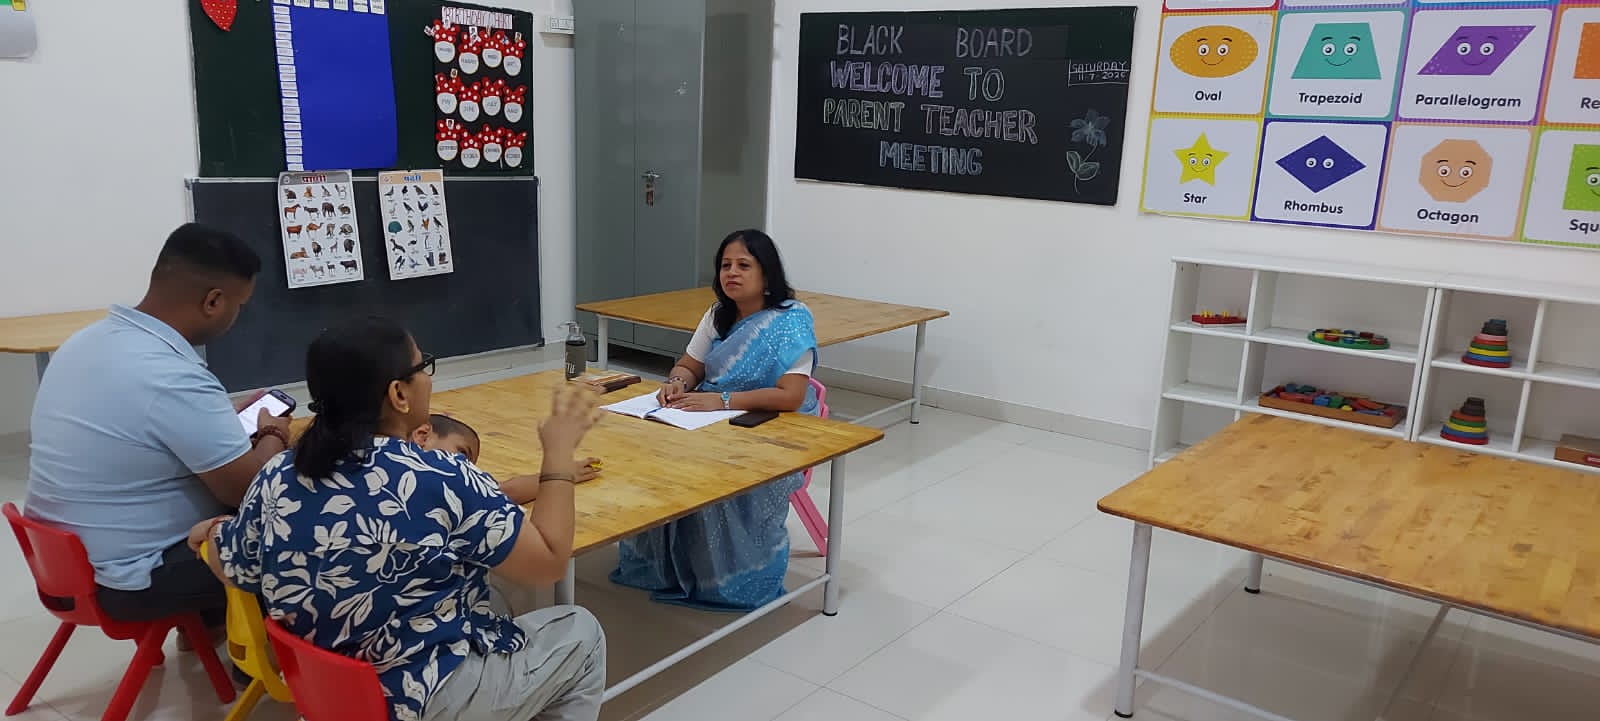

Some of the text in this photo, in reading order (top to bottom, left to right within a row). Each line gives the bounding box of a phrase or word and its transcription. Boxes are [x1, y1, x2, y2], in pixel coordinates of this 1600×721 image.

[837, 24, 1033, 58] BLACK BOARD
[1072, 61, 1127, 72] SATURDAY
[831, 61, 1005, 102] WELCOME TO
[1195, 90, 1222, 101] Oval
[1298, 92, 1363, 106] Trapezoid
[1415, 94, 1522, 110] Parallelogram
[823, 98, 1038, 144] PARENT TEACHER
[879, 141, 983, 175] MEETING
[1183, 192, 1208, 205] Star
[1283, 199, 1344, 215] Rhombus
[1416, 208, 1479, 225] Octagon
